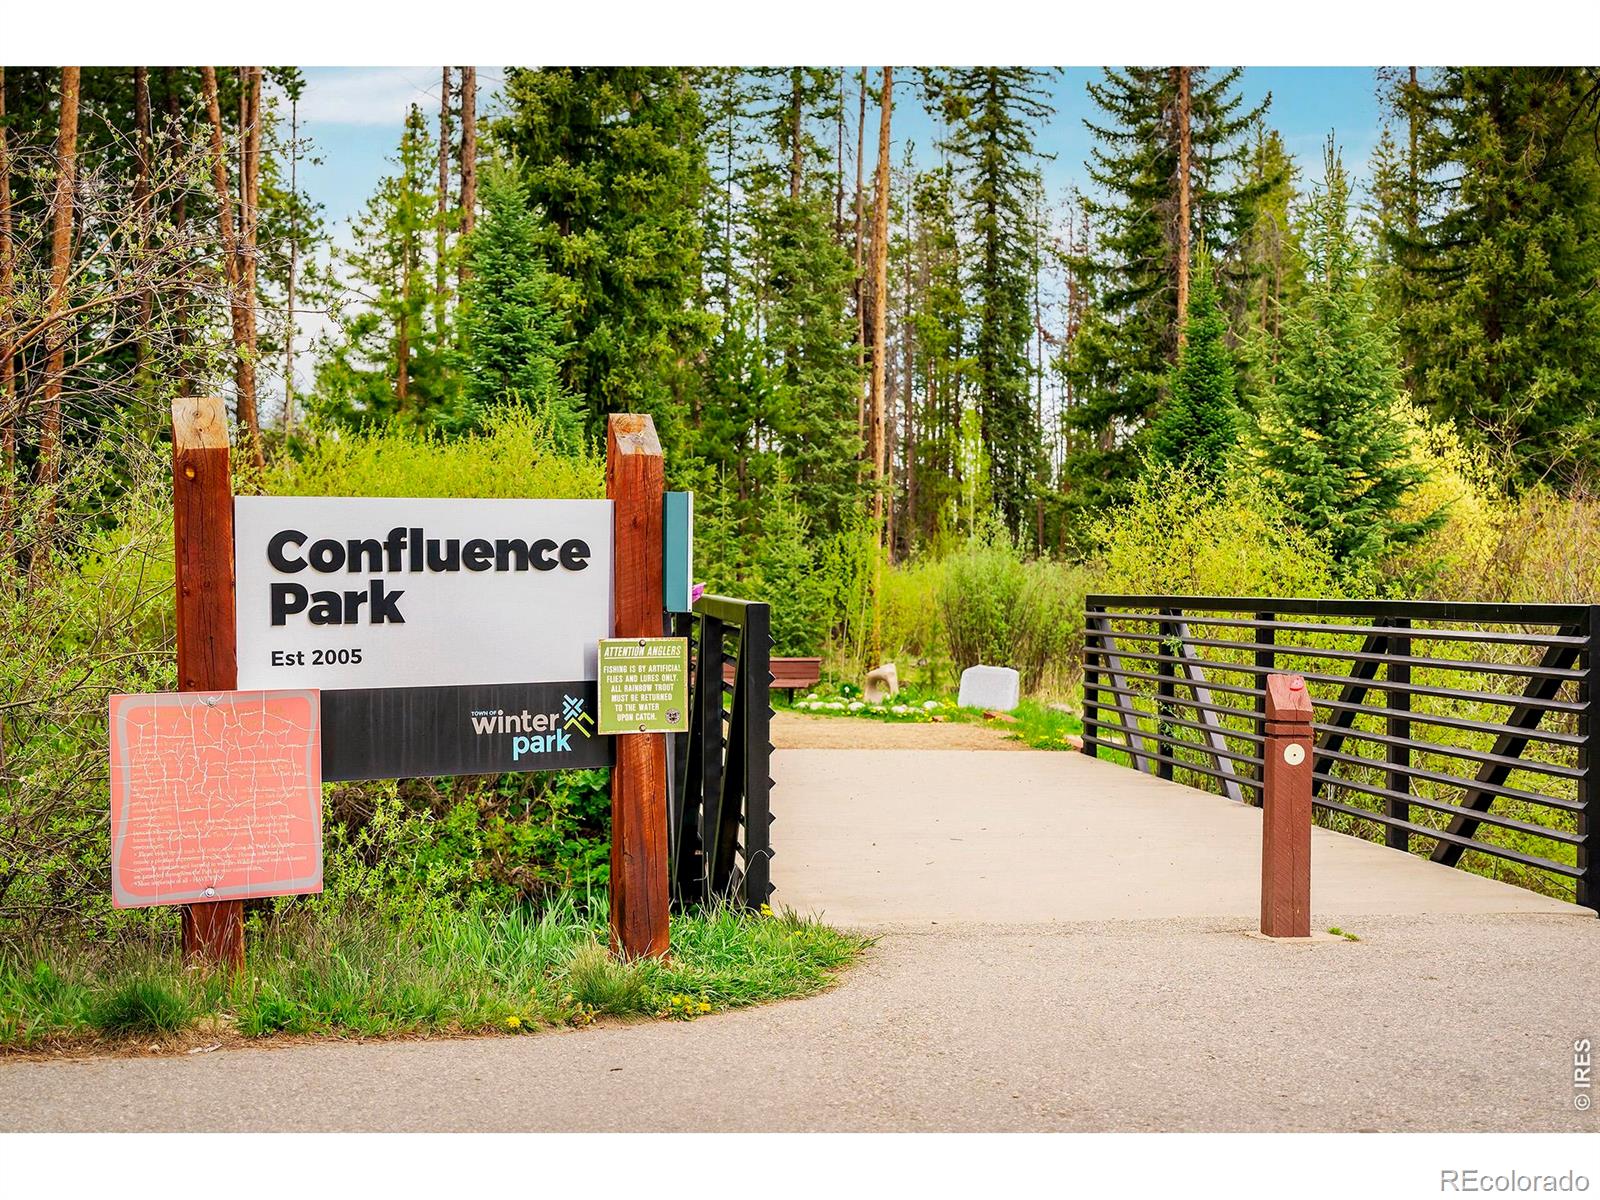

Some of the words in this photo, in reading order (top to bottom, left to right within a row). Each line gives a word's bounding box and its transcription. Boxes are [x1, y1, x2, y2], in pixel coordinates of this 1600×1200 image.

[267, 527, 591, 574] Confluence
[270, 579, 406, 626] Park
[604, 646, 645, 657] ATTENTION
[647, 645, 682, 656] ANGLERS
[271, 650, 305, 666] Est
[312, 649, 363, 665] 2005
[603, 665, 628, 674] FISHING
[629, 665, 636, 673] IS
[638, 665, 646, 673] BY
[648, 664, 682, 673] ARTIFICIAL
[606, 675, 623, 683] FLIES
[640, 674, 660, 682] LURES
[661, 673, 679, 682] ONLY.
[611, 684, 622, 693] ALL
[624, 684, 653, 692] RAINBOW
[655, 683, 674, 692] TROUT
[611, 694, 629, 703] MUST
[630, 694, 639, 702] BE
[640, 693, 673, 702] RETURNED
[615, 704, 623, 712] TO
[625, 703, 637, 711] THE
[638, 703, 660, 711] WATER
[471, 709, 560, 735] winter
[617, 713, 634, 722] UPON
[513, 728, 572, 761] park
